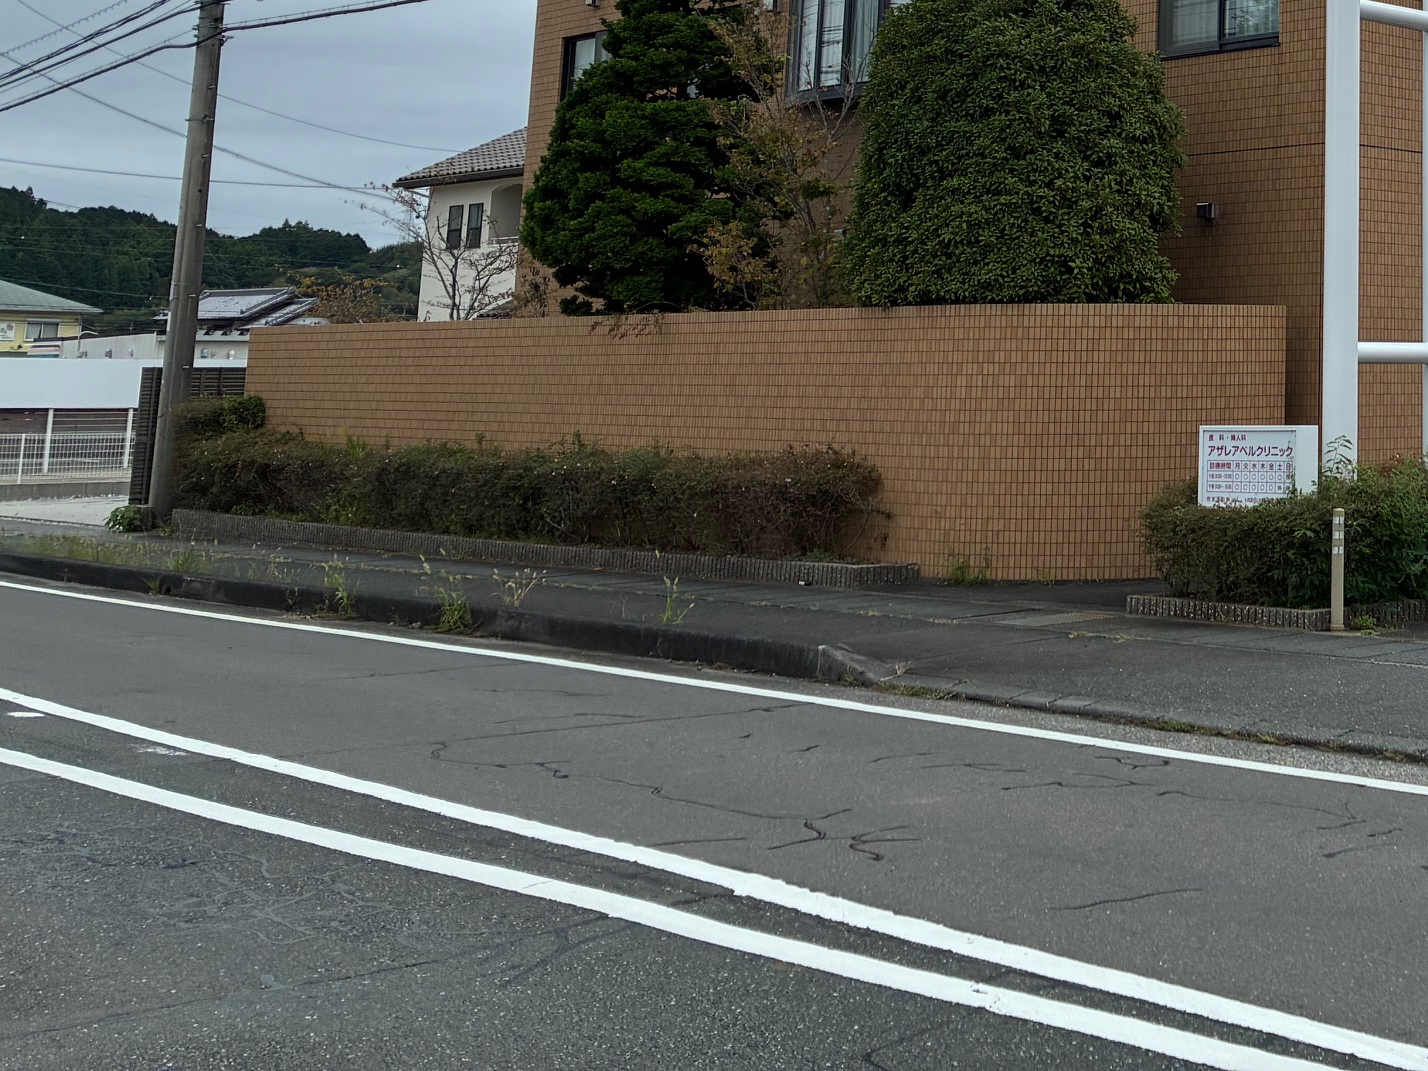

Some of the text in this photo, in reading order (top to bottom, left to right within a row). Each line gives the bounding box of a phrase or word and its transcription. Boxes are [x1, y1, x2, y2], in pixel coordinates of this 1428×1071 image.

[1208, 445, 1293, 457] アザレアベルクリニック
